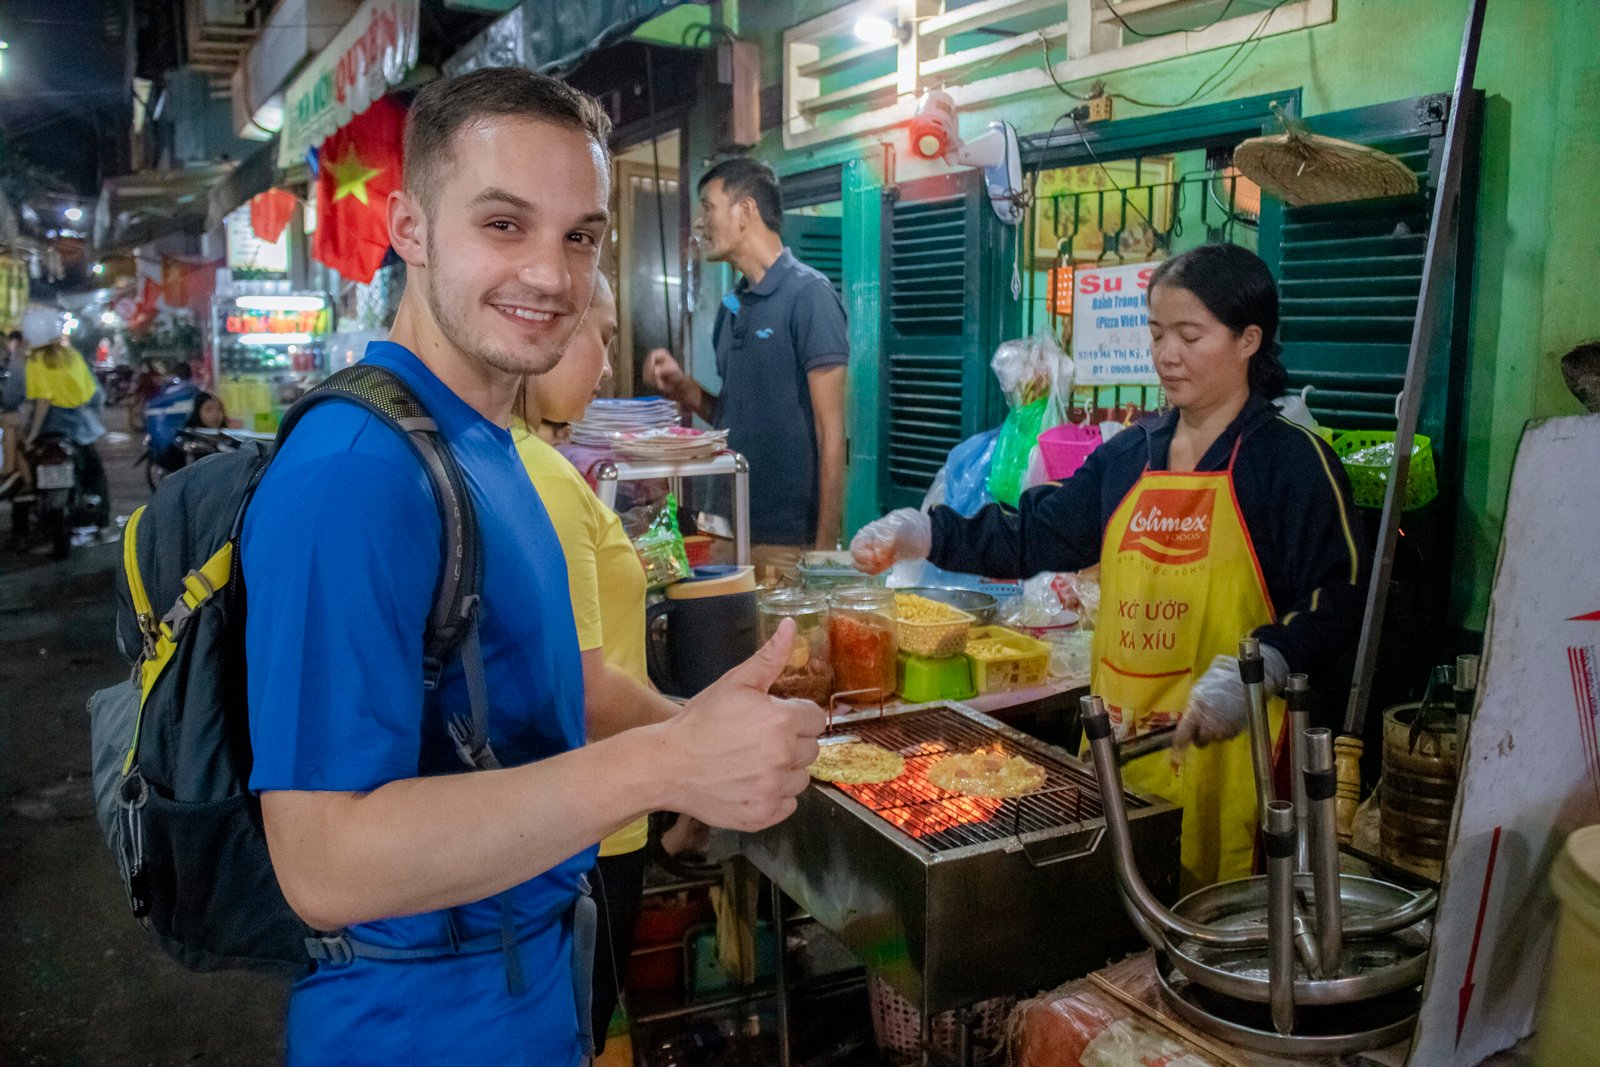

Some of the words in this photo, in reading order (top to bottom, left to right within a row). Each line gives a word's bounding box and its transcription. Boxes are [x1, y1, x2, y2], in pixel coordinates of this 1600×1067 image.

[1079, 273, 1122, 294] Su
[1145, 599, 1189, 621] ƯỚP
[1142, 628, 1176, 650] XÍU
